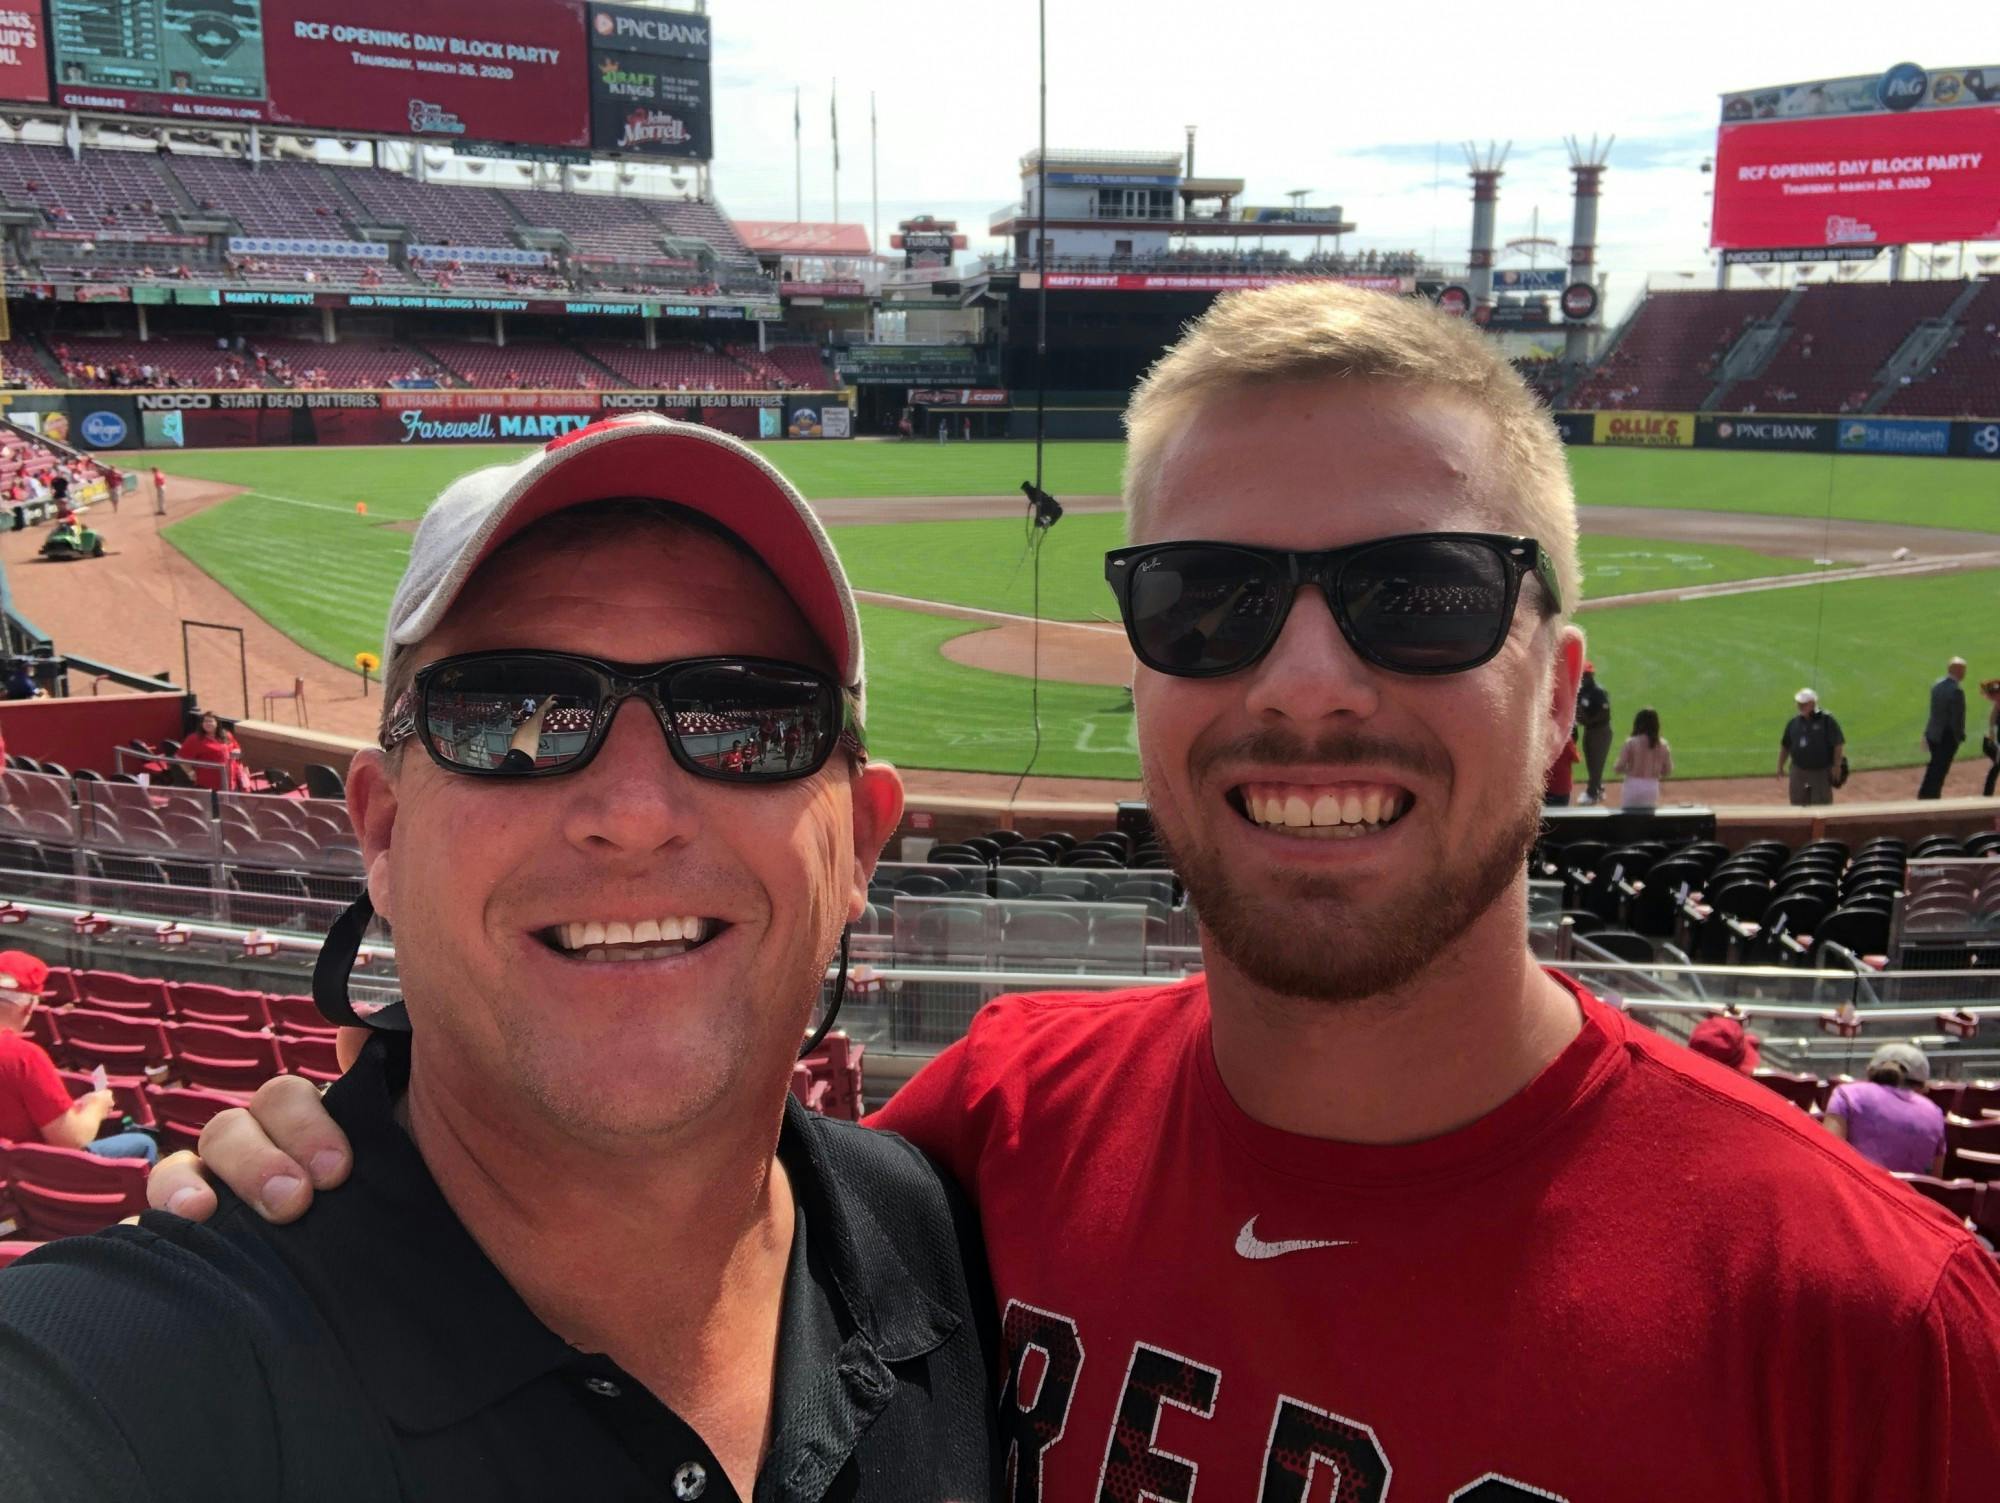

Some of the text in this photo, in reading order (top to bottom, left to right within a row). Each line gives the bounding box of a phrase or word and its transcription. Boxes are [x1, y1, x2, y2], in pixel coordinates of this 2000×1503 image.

[615, 16, 708, 46] PNC BANK
[294, 20, 559, 65] RCF OPENING DAY BLOCK PARTY
[480, 65, 514, 80] 2020
[603, 71, 656, 86] DRAFT
[609, 83, 655, 98] KINGS
[617, 119, 690, 147] Morrell
[1738, 152, 1983, 180] RCF OPENING DAY BLOCK PARTY
[905, 237, 949, 248] TUNDRA
[137, 395, 212, 409] NOCO
[219, 395, 263, 408] START
[267, 395, 304, 408] DEAD
[307, 395, 380, 408] BATTERIES.
[386, 395, 453, 408] ULTRASAFE
[458, 395, 504, 408] LITHIUM
[507, 395, 538, 408] JUMP
[602, 395, 659, 408] NOCO
[665, 395, 700, 408] START
[702, 395, 729, 408] DEAD
[500, 415, 591, 437] MARTY
[1609, 418, 1679, 437] OLLIE'S
[1736, 422, 1818, 440] PNC BANK
[997, 1298, 1570, 1503] RE
